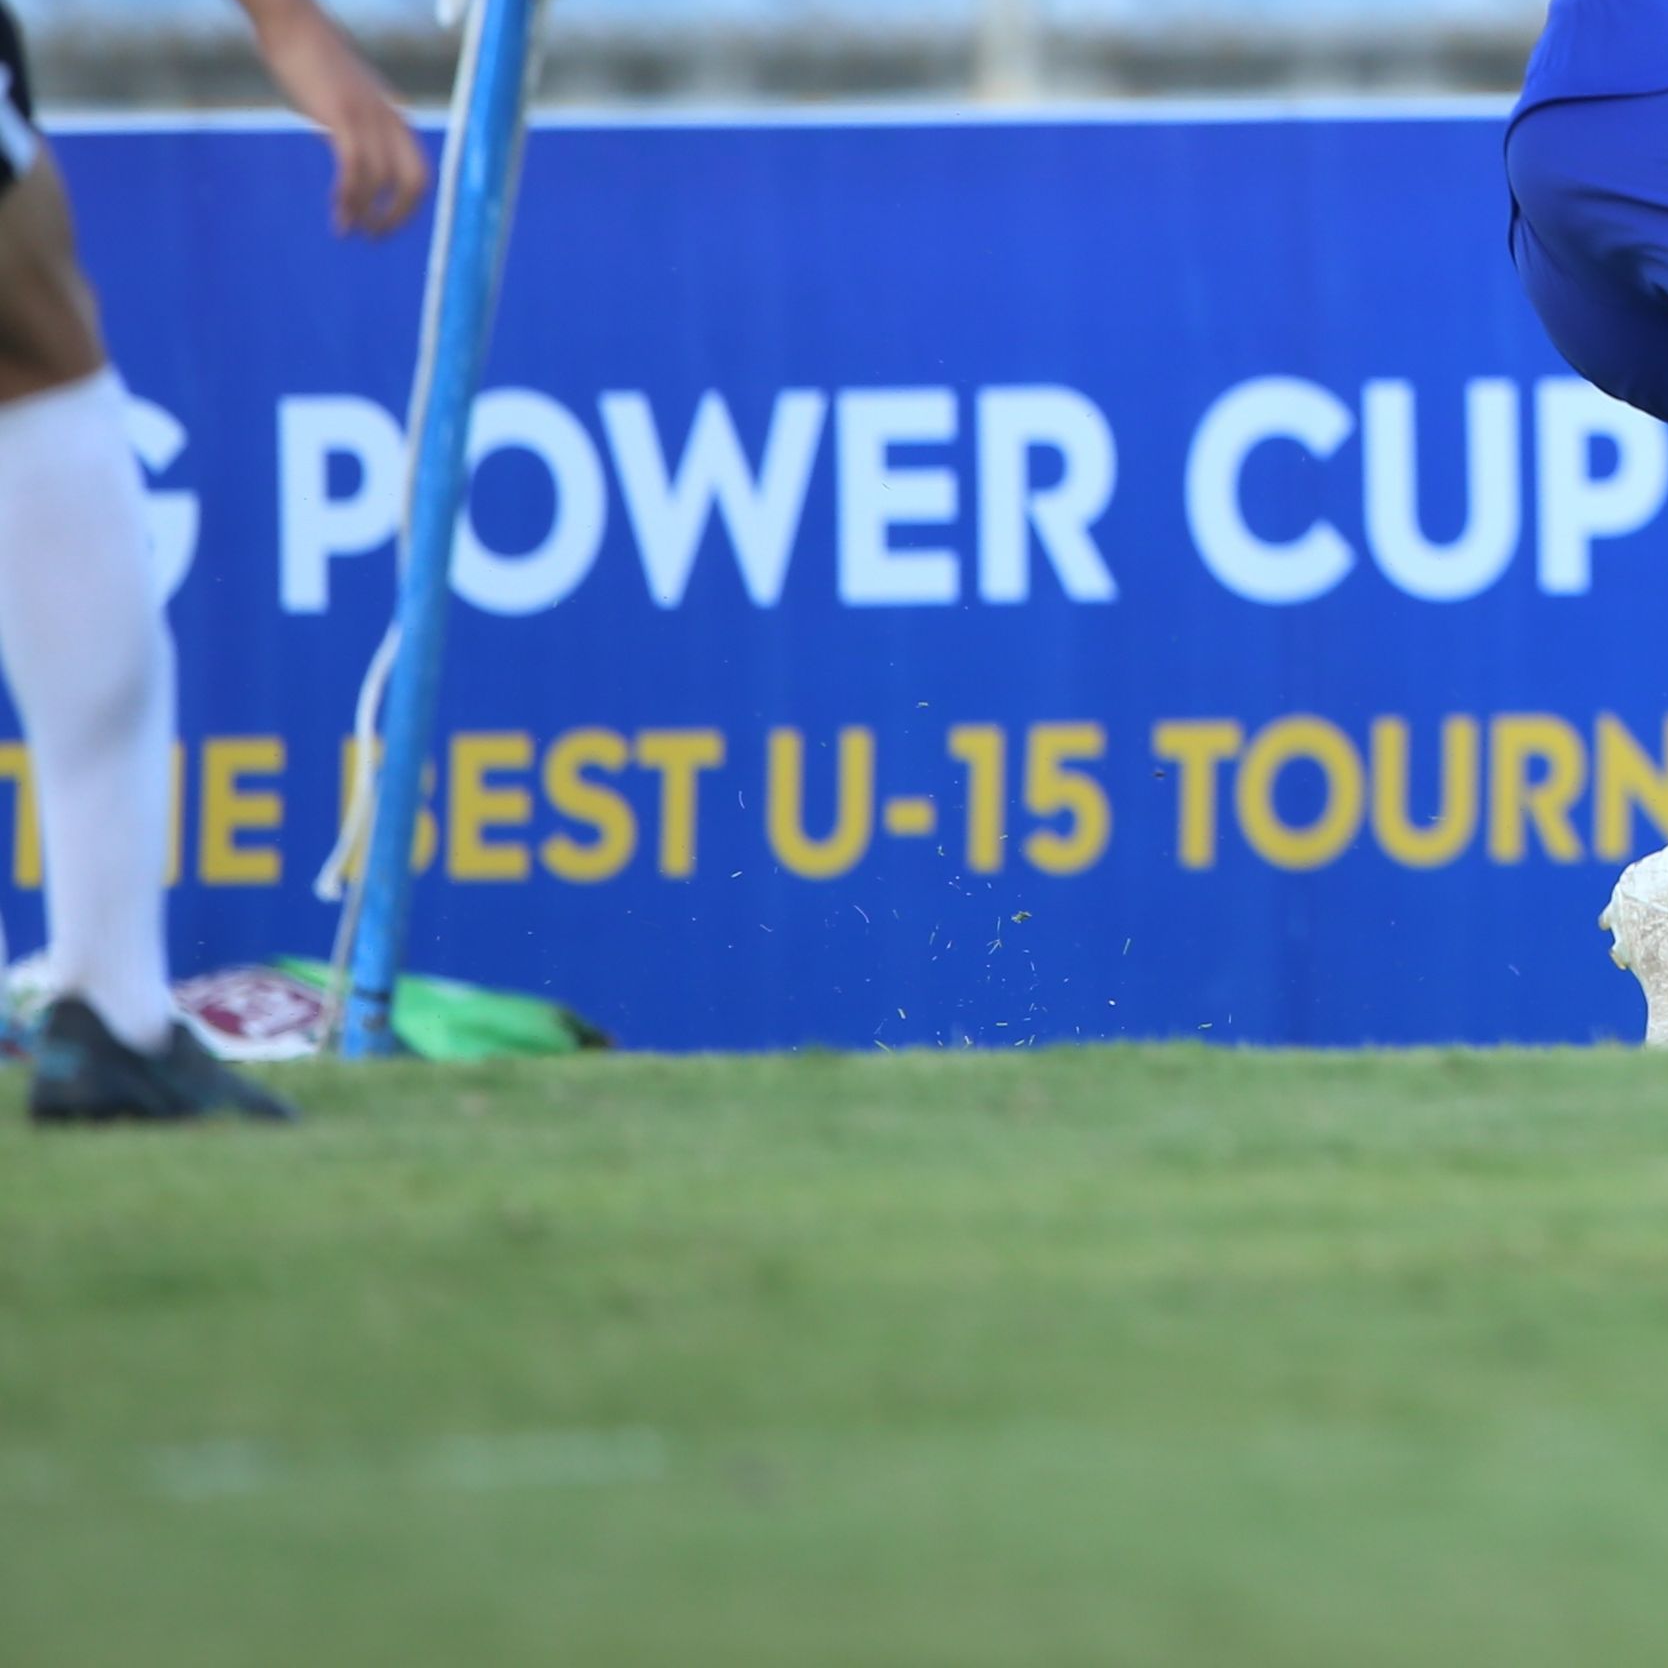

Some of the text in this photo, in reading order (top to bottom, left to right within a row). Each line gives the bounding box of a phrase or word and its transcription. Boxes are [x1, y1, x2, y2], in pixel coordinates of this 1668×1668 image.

[279, 387, 1118, 613] POWER
[0, 737, 285, 888] TE
[768, 725, 1109, 876] U-15
